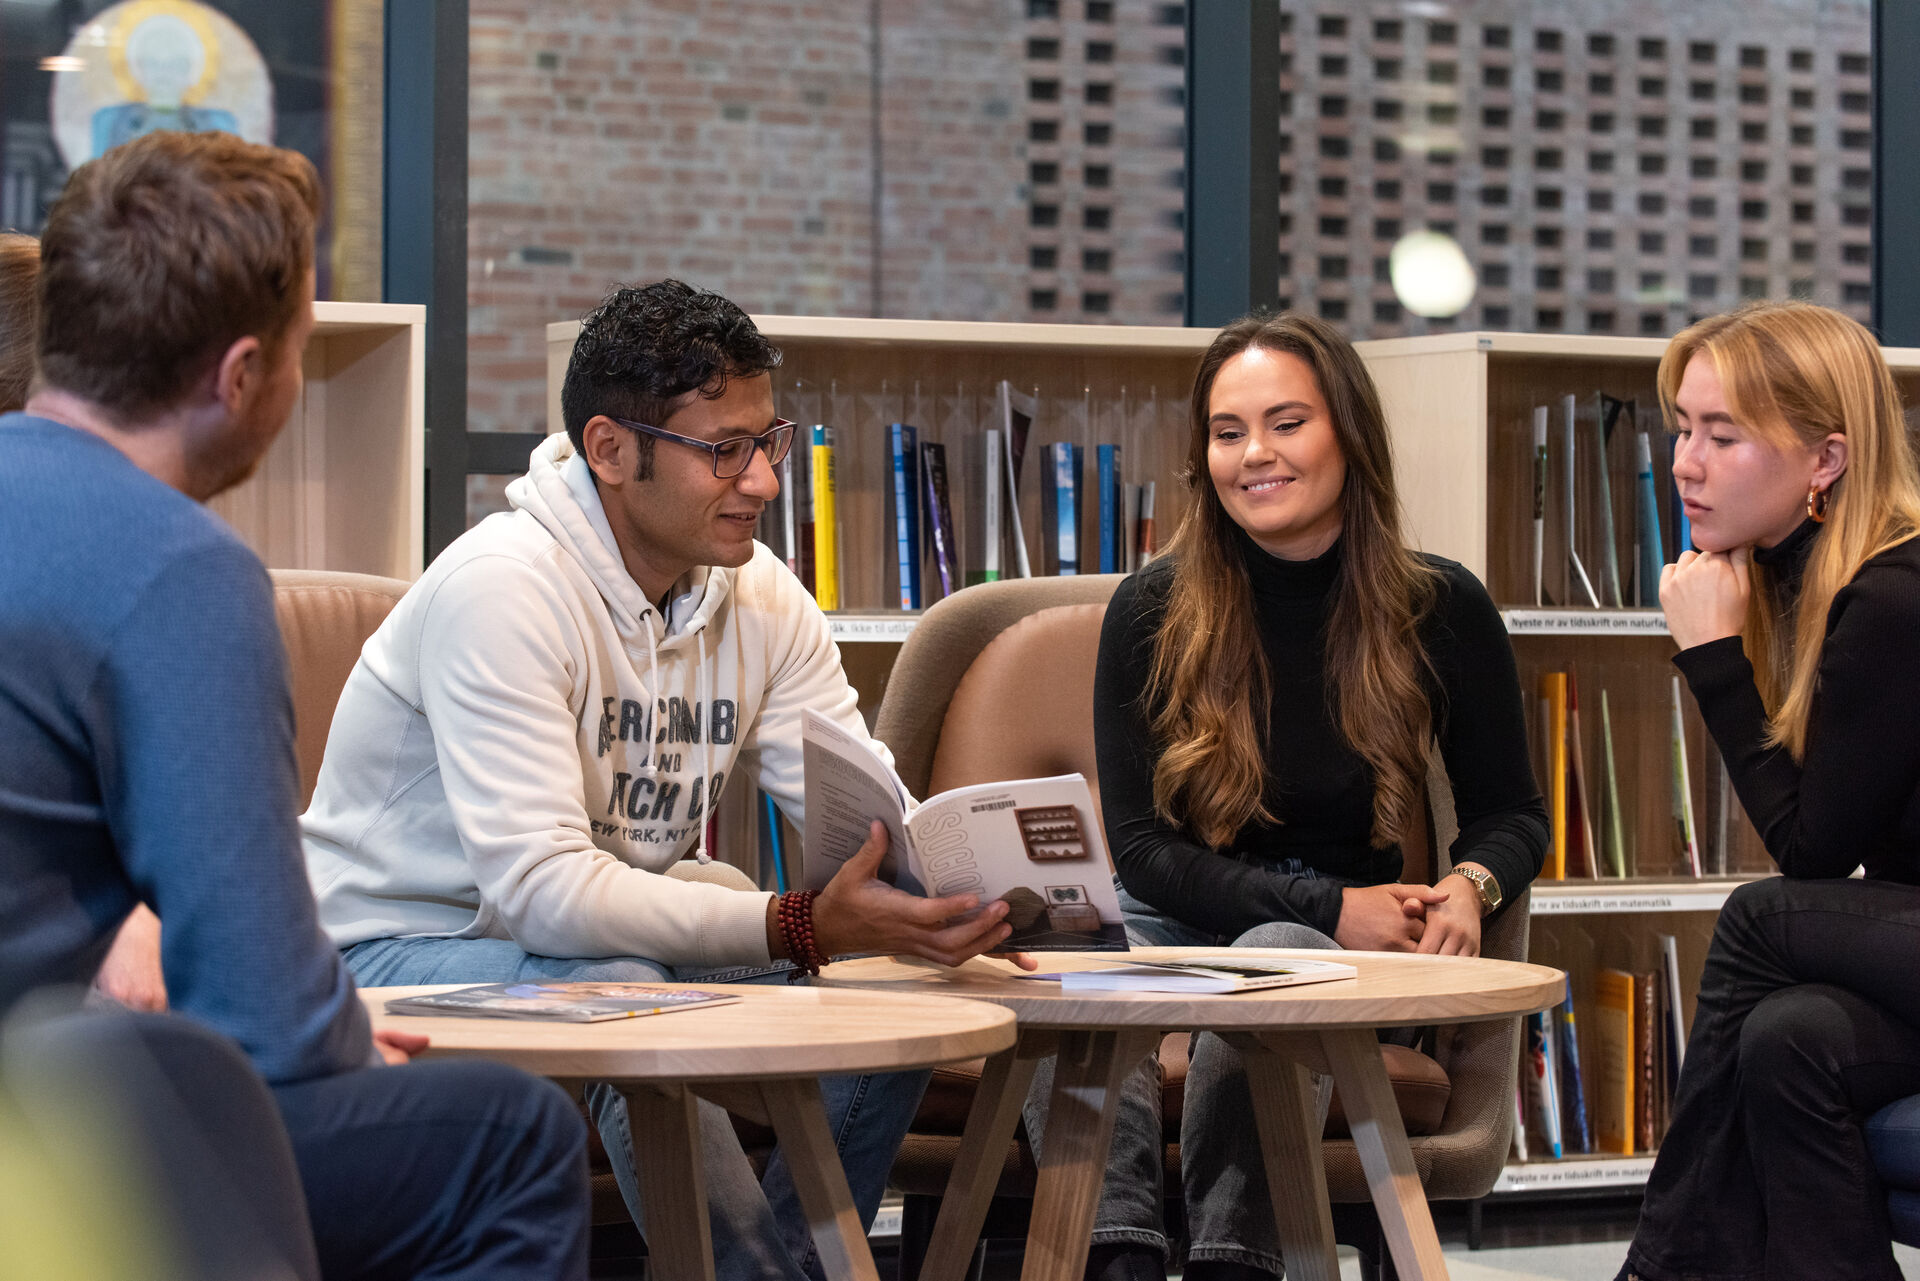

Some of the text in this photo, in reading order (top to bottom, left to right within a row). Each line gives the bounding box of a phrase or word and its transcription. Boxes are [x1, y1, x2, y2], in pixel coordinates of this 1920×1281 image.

[1511, 617, 1541, 629] Nyeste
[1545, 619, 1555, 627] nr
[1558, 619, 1568, 627] av
[1571, 616, 1610, 627] tidsskrift
[590, 819, 689, 844] EW YORK, NY
[1538, 901, 1547, 909] nr
[1563, 899, 1600, 909] tidsskrift
[1620, 899, 1671, 908] matematikk
[1507, 1174, 1537, 1184] Nyeste
[1552, 1173, 1562, 1181] av
[1564, 1170, 1602, 1180] tidsskrift
